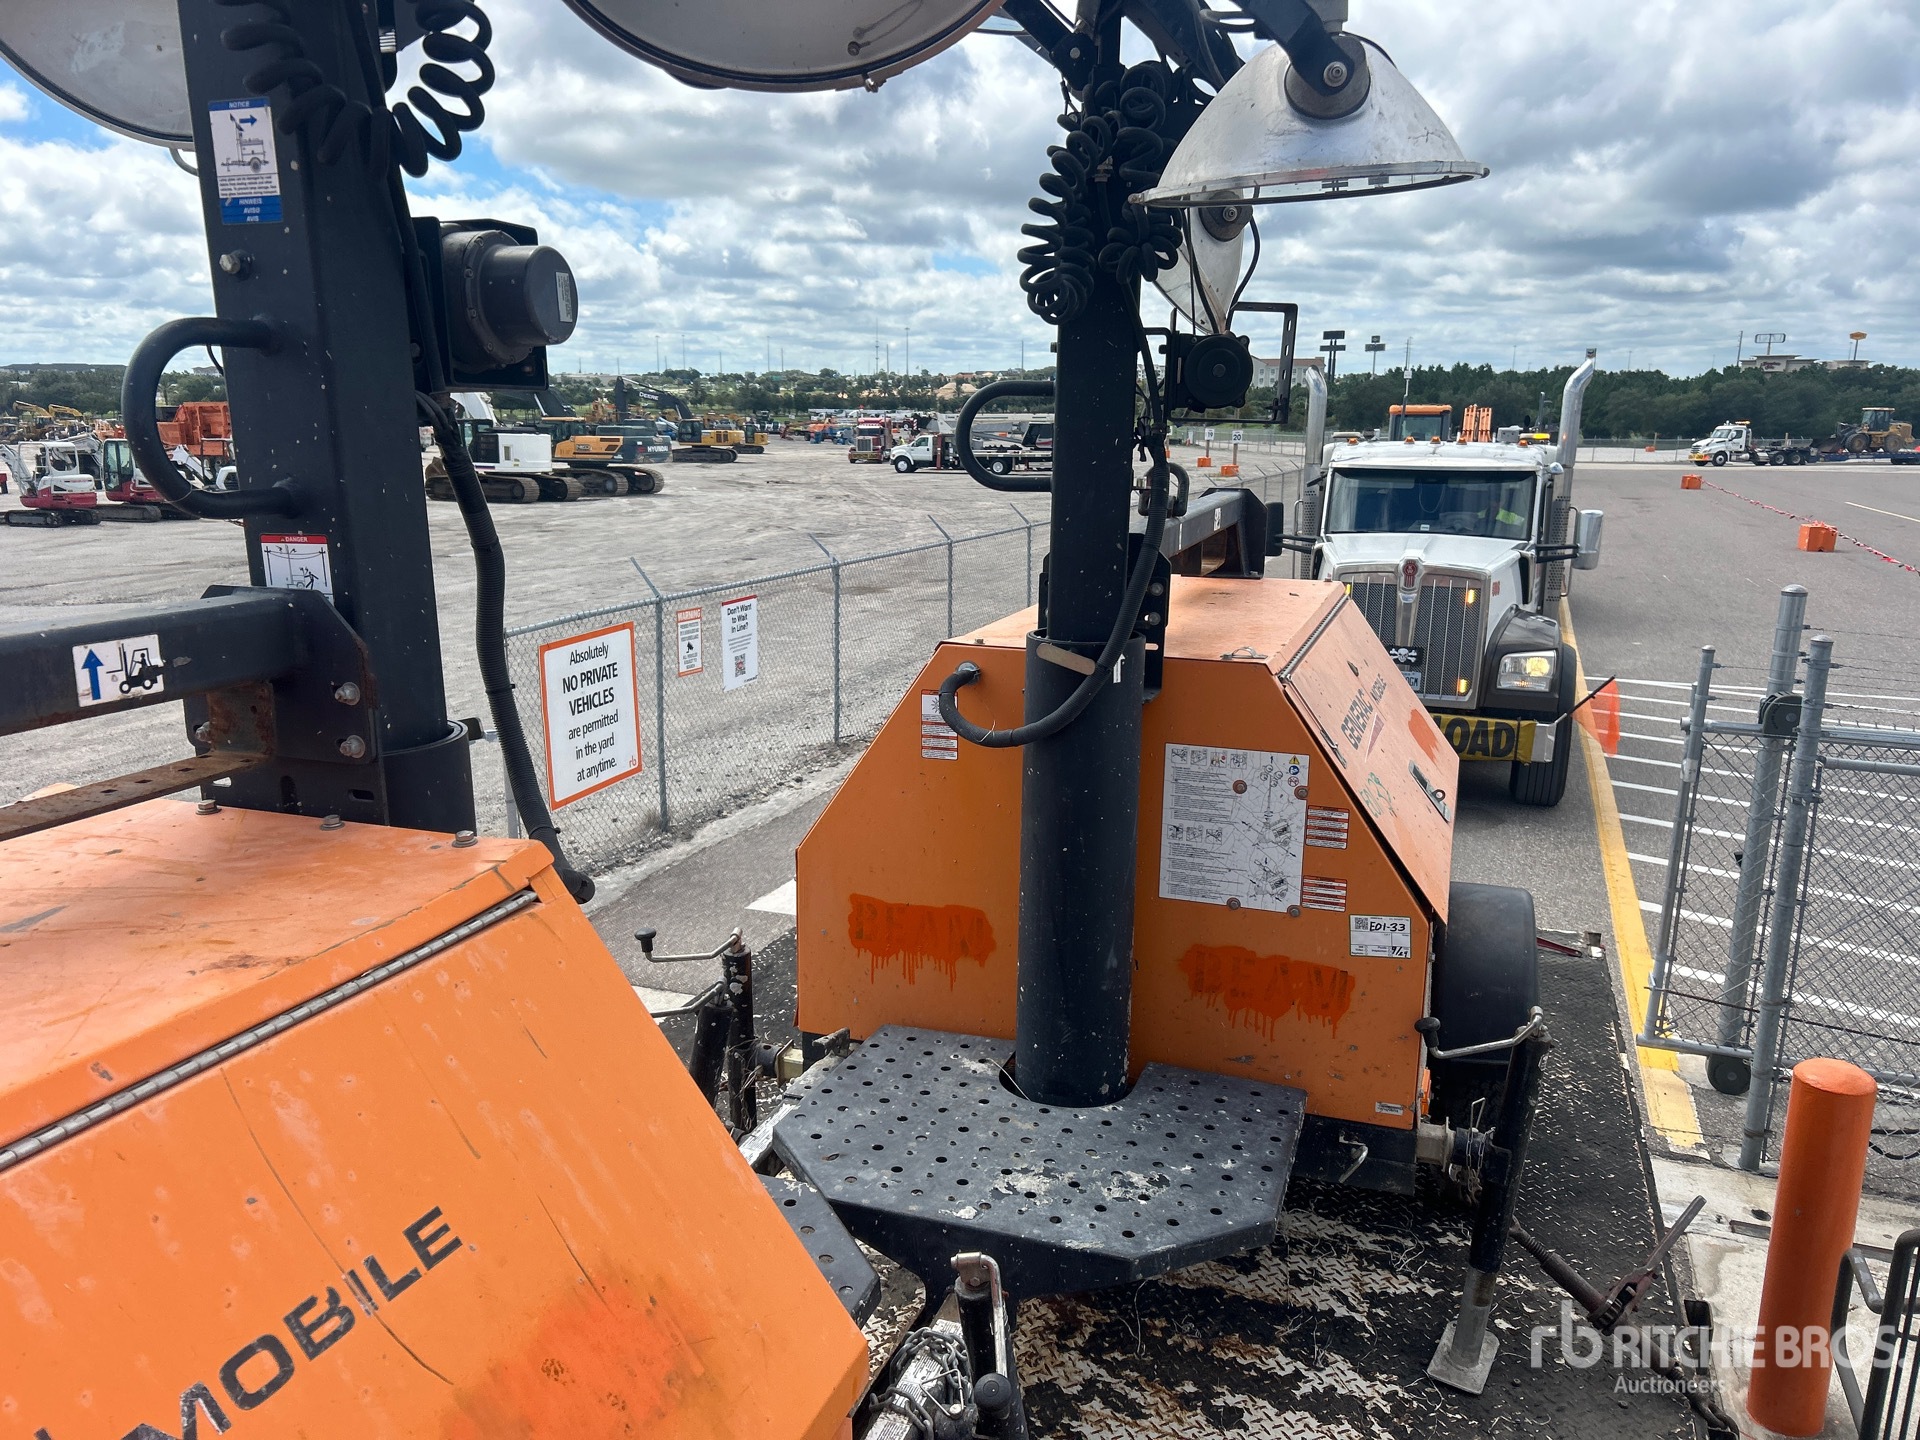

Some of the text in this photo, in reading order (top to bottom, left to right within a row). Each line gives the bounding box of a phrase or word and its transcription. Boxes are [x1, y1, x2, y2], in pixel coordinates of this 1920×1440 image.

[639, 391, 659, 400] DEERE
[727, 603, 752, 616] Don't Want
[732, 613, 748, 624] to Wait
[737, 622, 748, 632] Line?
[569, 641, 609, 666] Absolutely
[562, 662, 618, 694] NO PRIVATE
[569, 687, 615, 716] VEHICLES
[568, 708, 619, 740] are permitted
[1341, 688, 1374, 750] GENERAC
[575, 732, 615, 760] in the yard
[577, 758, 617, 782] at anytime.
[1370, 921, 1406, 932] E01-33
